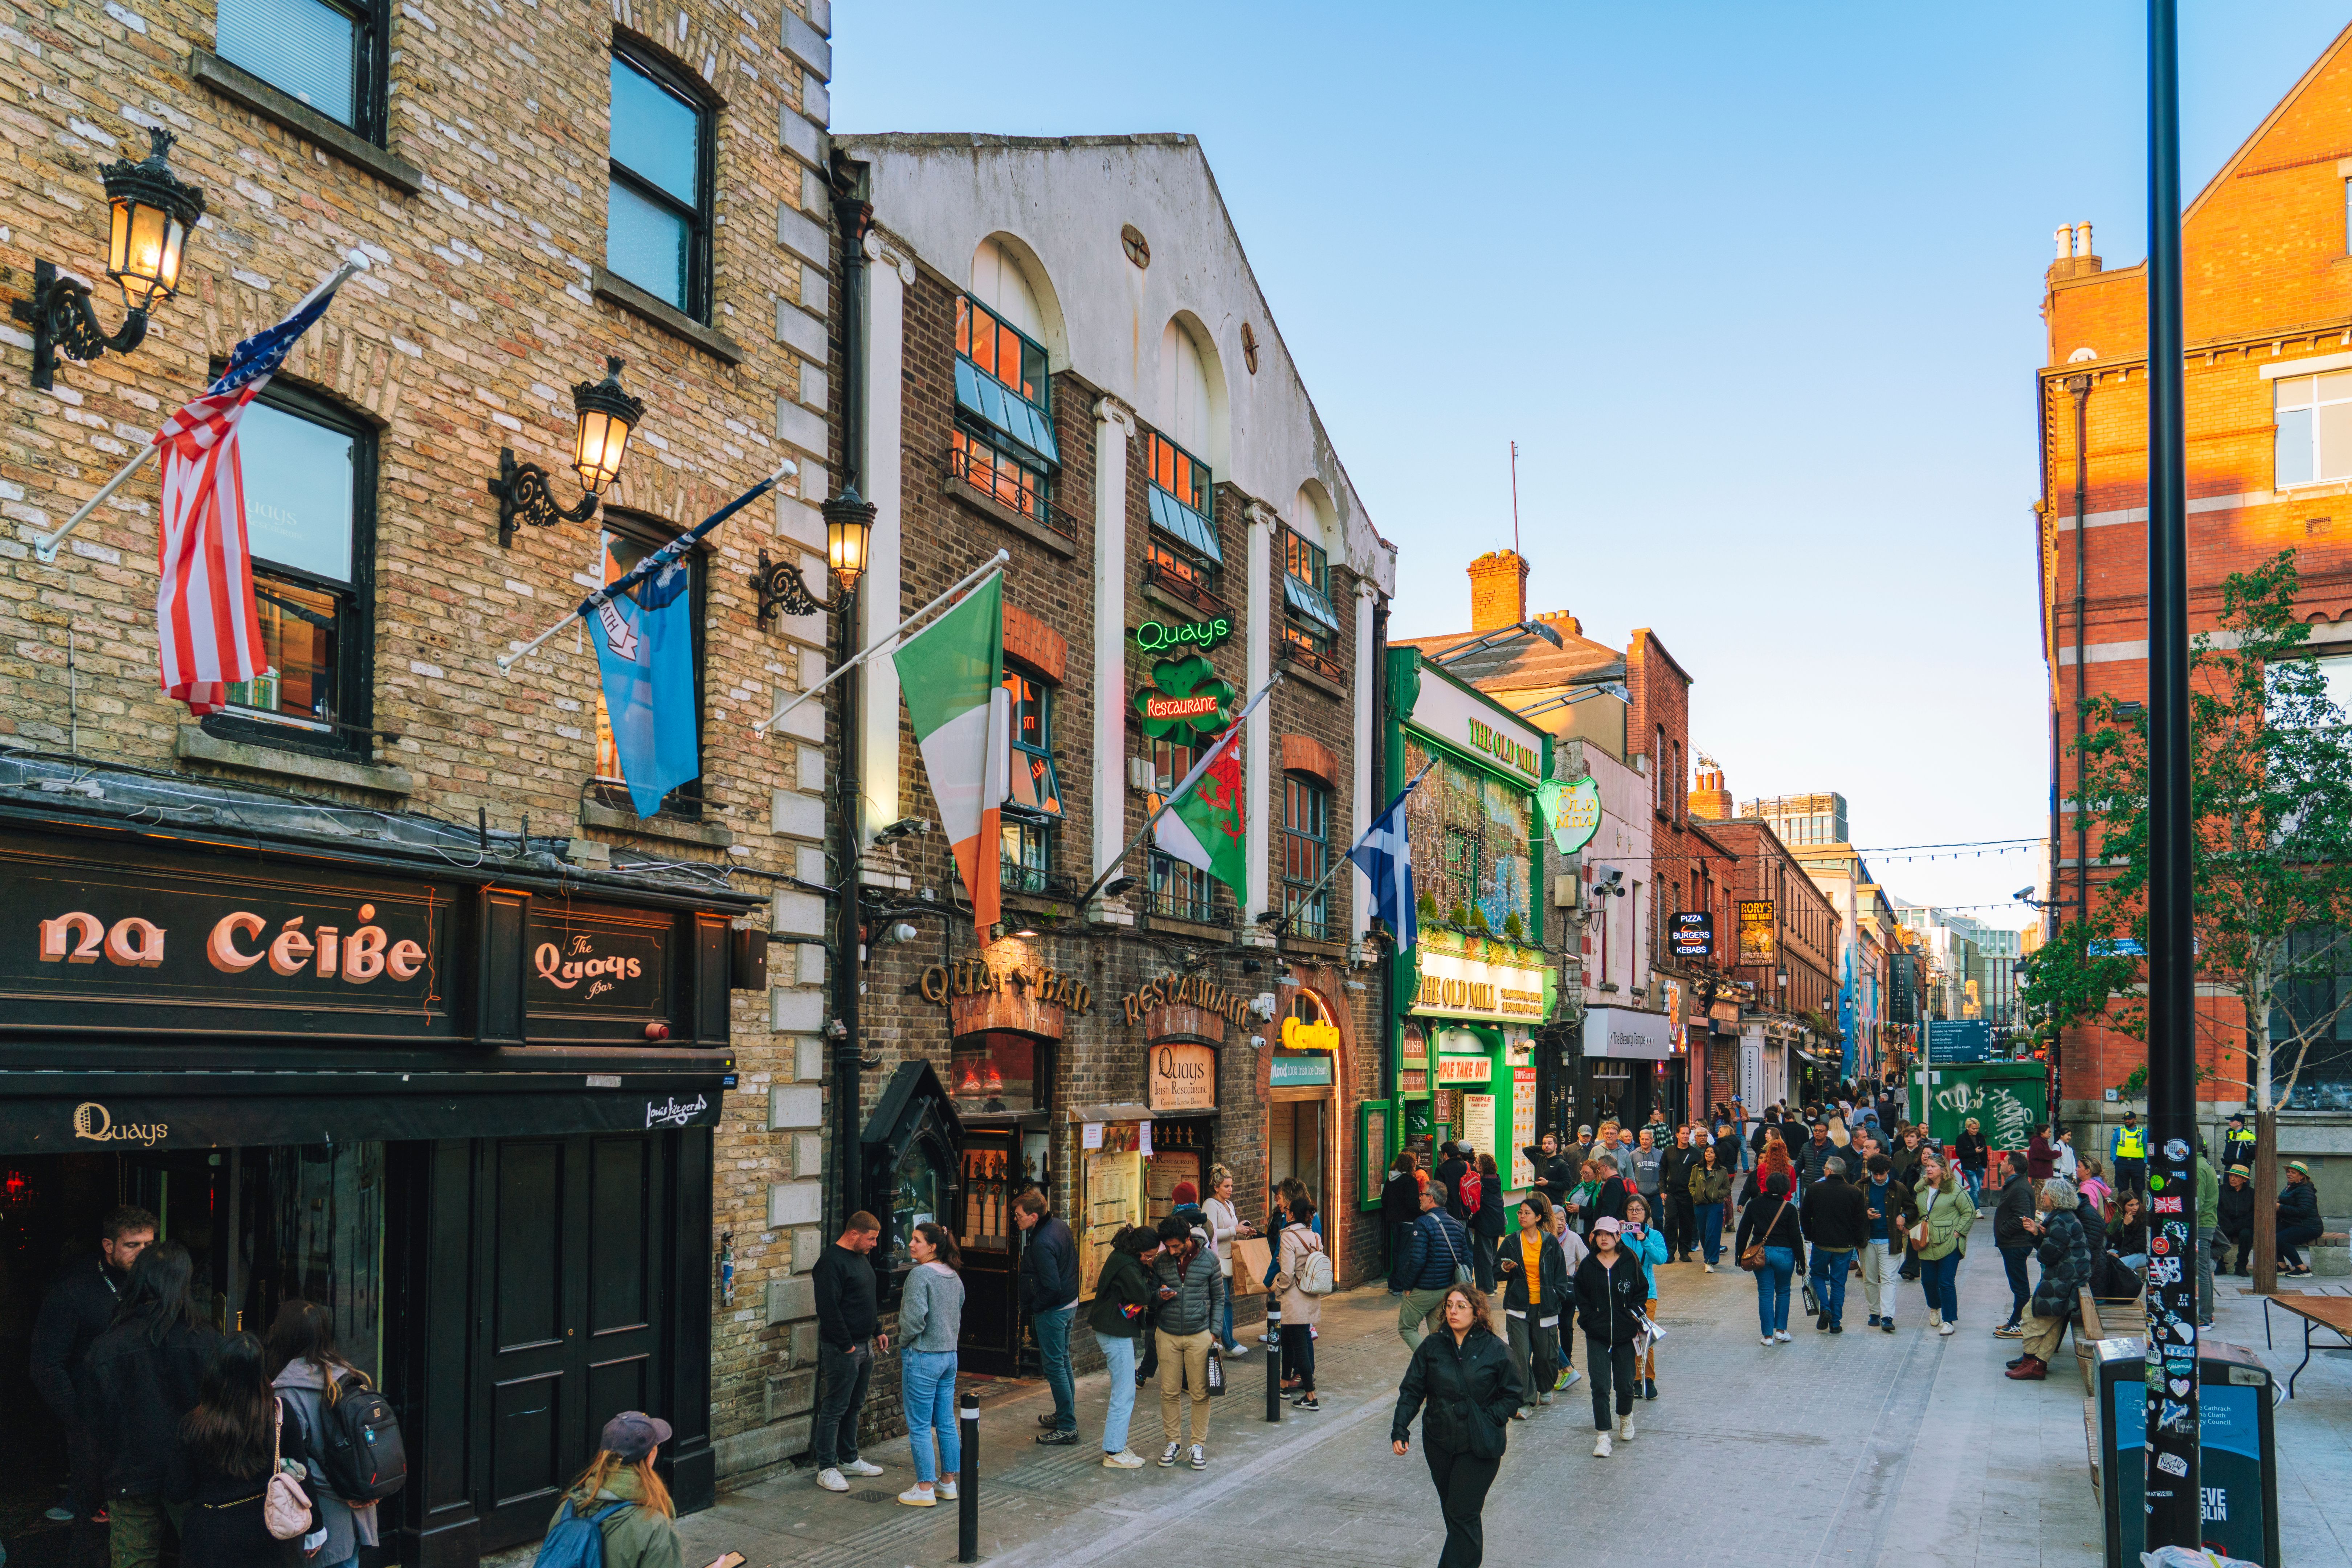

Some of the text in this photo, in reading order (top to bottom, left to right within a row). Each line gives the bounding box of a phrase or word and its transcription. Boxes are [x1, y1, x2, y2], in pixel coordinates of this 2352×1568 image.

[244, 492, 297, 525] uays
[1138, 619, 1227, 650] Quays
[1147, 697, 1217, 717] Restaurant
[1469, 716, 1541, 778] THE OLD MILL
[1556, 795, 1596, 813] OLD
[1556, 814, 1595, 828] MILL
[1741, 902, 1773, 914] RORY'S
[568, 935, 594, 956] The
[535, 943, 642, 989] Quays
[585, 980, 615, 1000] Bar
[1443, 978, 1467, 1006] OLD
[1469, 981, 1497, 1010] MILL
[1503, 1002, 1530, 1013] RESTAURANT
[1281, 1016, 1340, 1050] Centra
[1620, 1032, 1633, 1046] Beauty
[1634, 1032, 1645, 1047] Temple
[1404, 1040, 1422, 1053] IRISH
[1159, 1046, 1204, 1085] Quays
[1288, 1066, 1298, 1075] 100%
[1298, 1065, 1307, 1075] Irish
[1314, 1065, 1327, 1075] Cream
[1439, 1061, 1488, 1080] MPLE TAKE OUT
[1514, 1070, 1525, 1079] TEMPLE
[1155, 1081, 1208, 1095] Irish Restaurant
[1161, 1098, 1170, 1106] Open
[1438, 1096, 1447, 1107] OLD
[1438, 1107, 1447, 1116] MILL
[73, 1102, 168, 1147] Quays
[1156, 1154, 1196, 1165] Restaurant
[104, 1276, 117, 1293] SECURITY
[2200, 1487, 2226, 1507] EVE
[2200, 1505, 2226, 1521] BLIN
